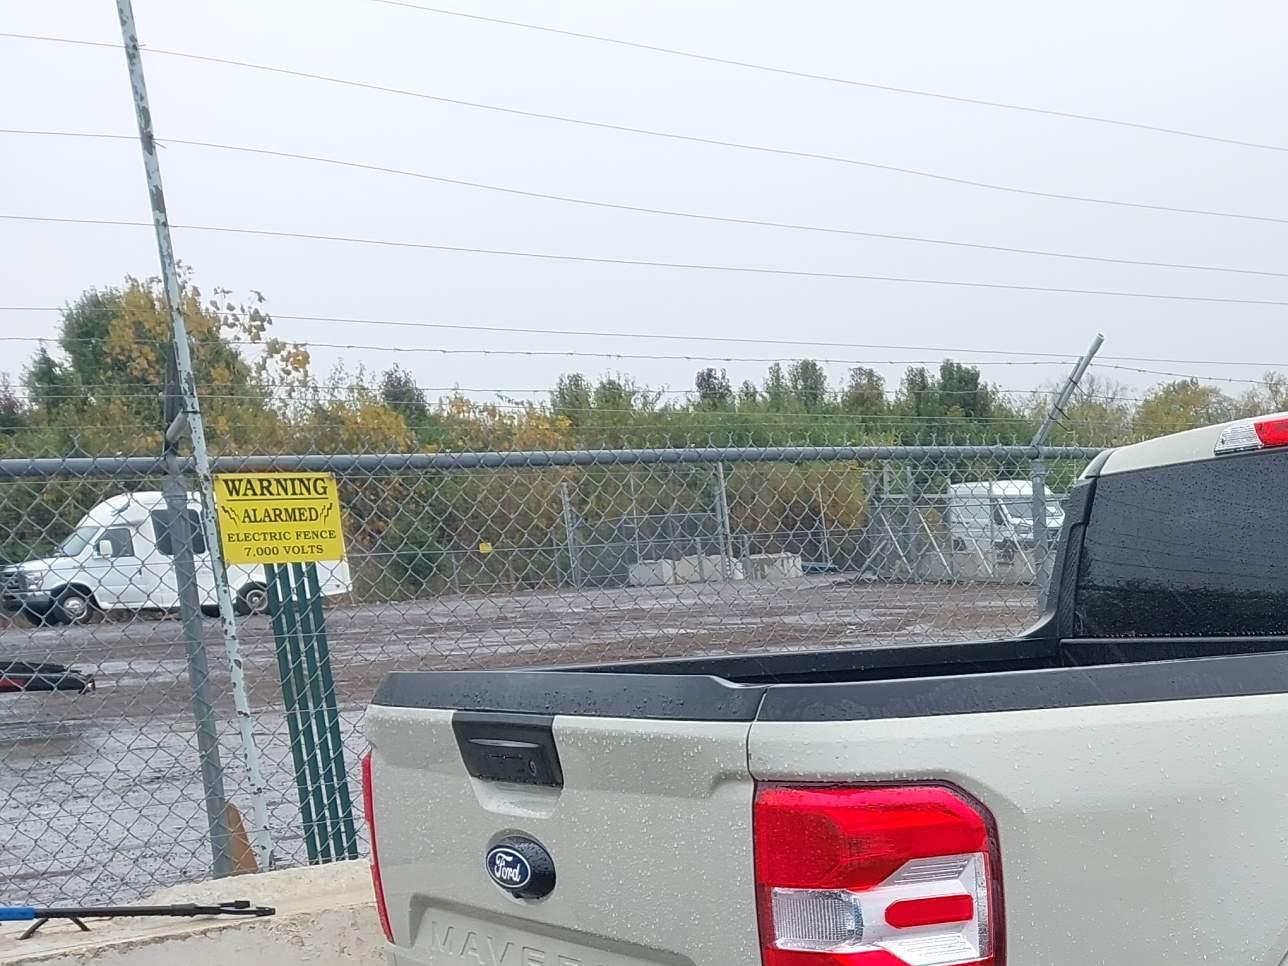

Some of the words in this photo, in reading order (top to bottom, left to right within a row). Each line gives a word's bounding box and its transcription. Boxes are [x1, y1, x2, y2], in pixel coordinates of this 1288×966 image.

[223, 478, 328, 497] WARNING
[241, 507, 319, 523] ALARMED
[227, 532, 291, 543] ELECTRIC
[295, 530, 337, 540] FENCE
[244, 546, 280, 557] 7,000
[283, 545, 324, 555] VOLTS
[494, 852, 522, 882] Ford
